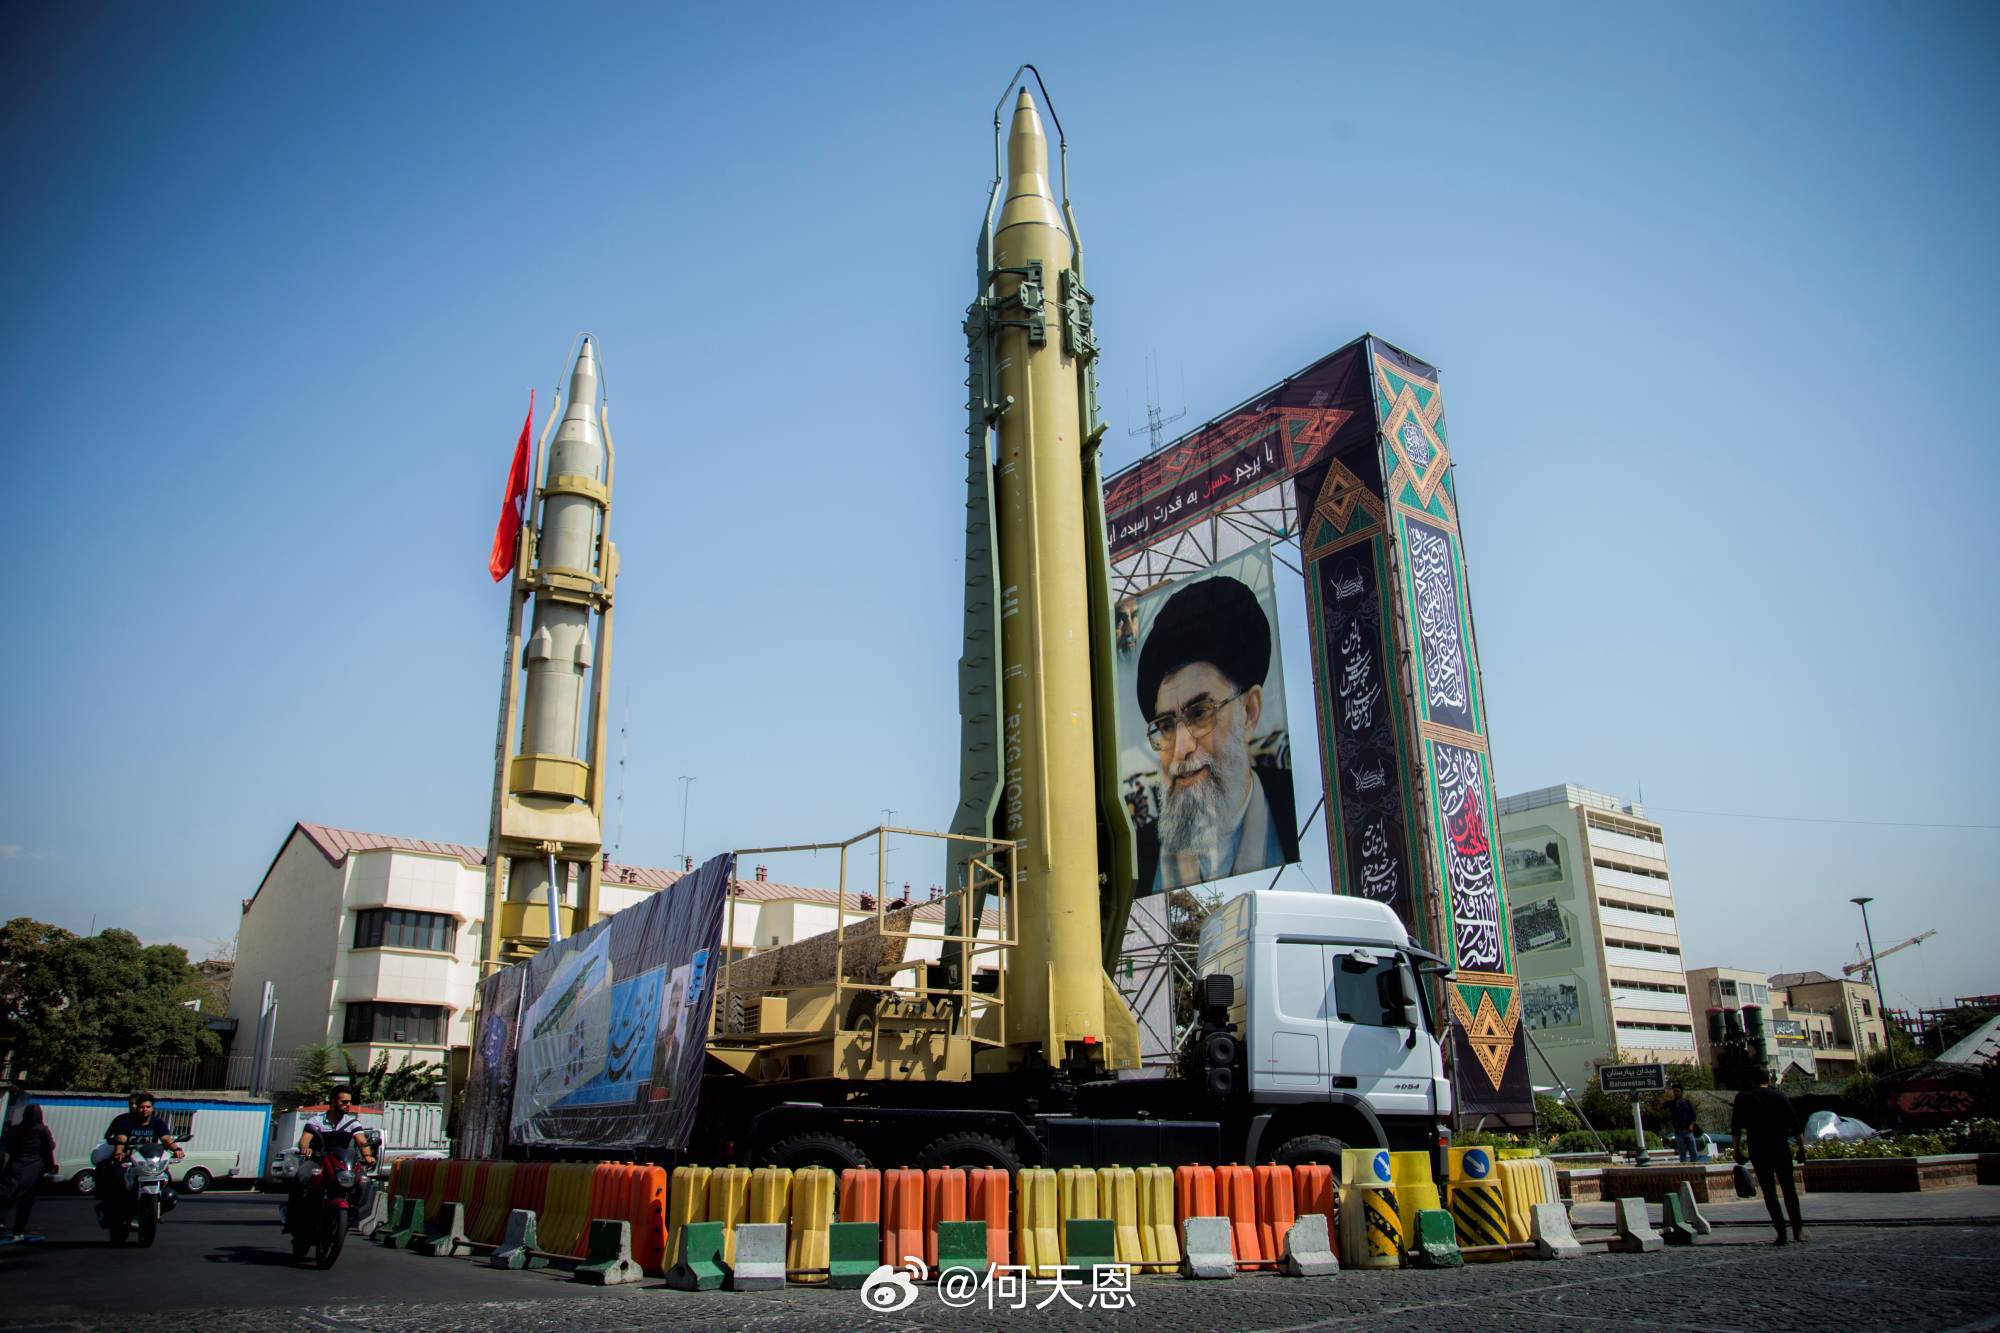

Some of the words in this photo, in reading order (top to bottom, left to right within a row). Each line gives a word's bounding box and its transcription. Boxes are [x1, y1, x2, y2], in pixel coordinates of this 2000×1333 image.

[1264, 441, 1274, 464] با
[1234, 455, 1261, 485] پرچم
[1186, 489, 1198, 505] به
[1153, 495, 1183, 526] قدرت
[1120, 514, 1149, 540] رسیده
